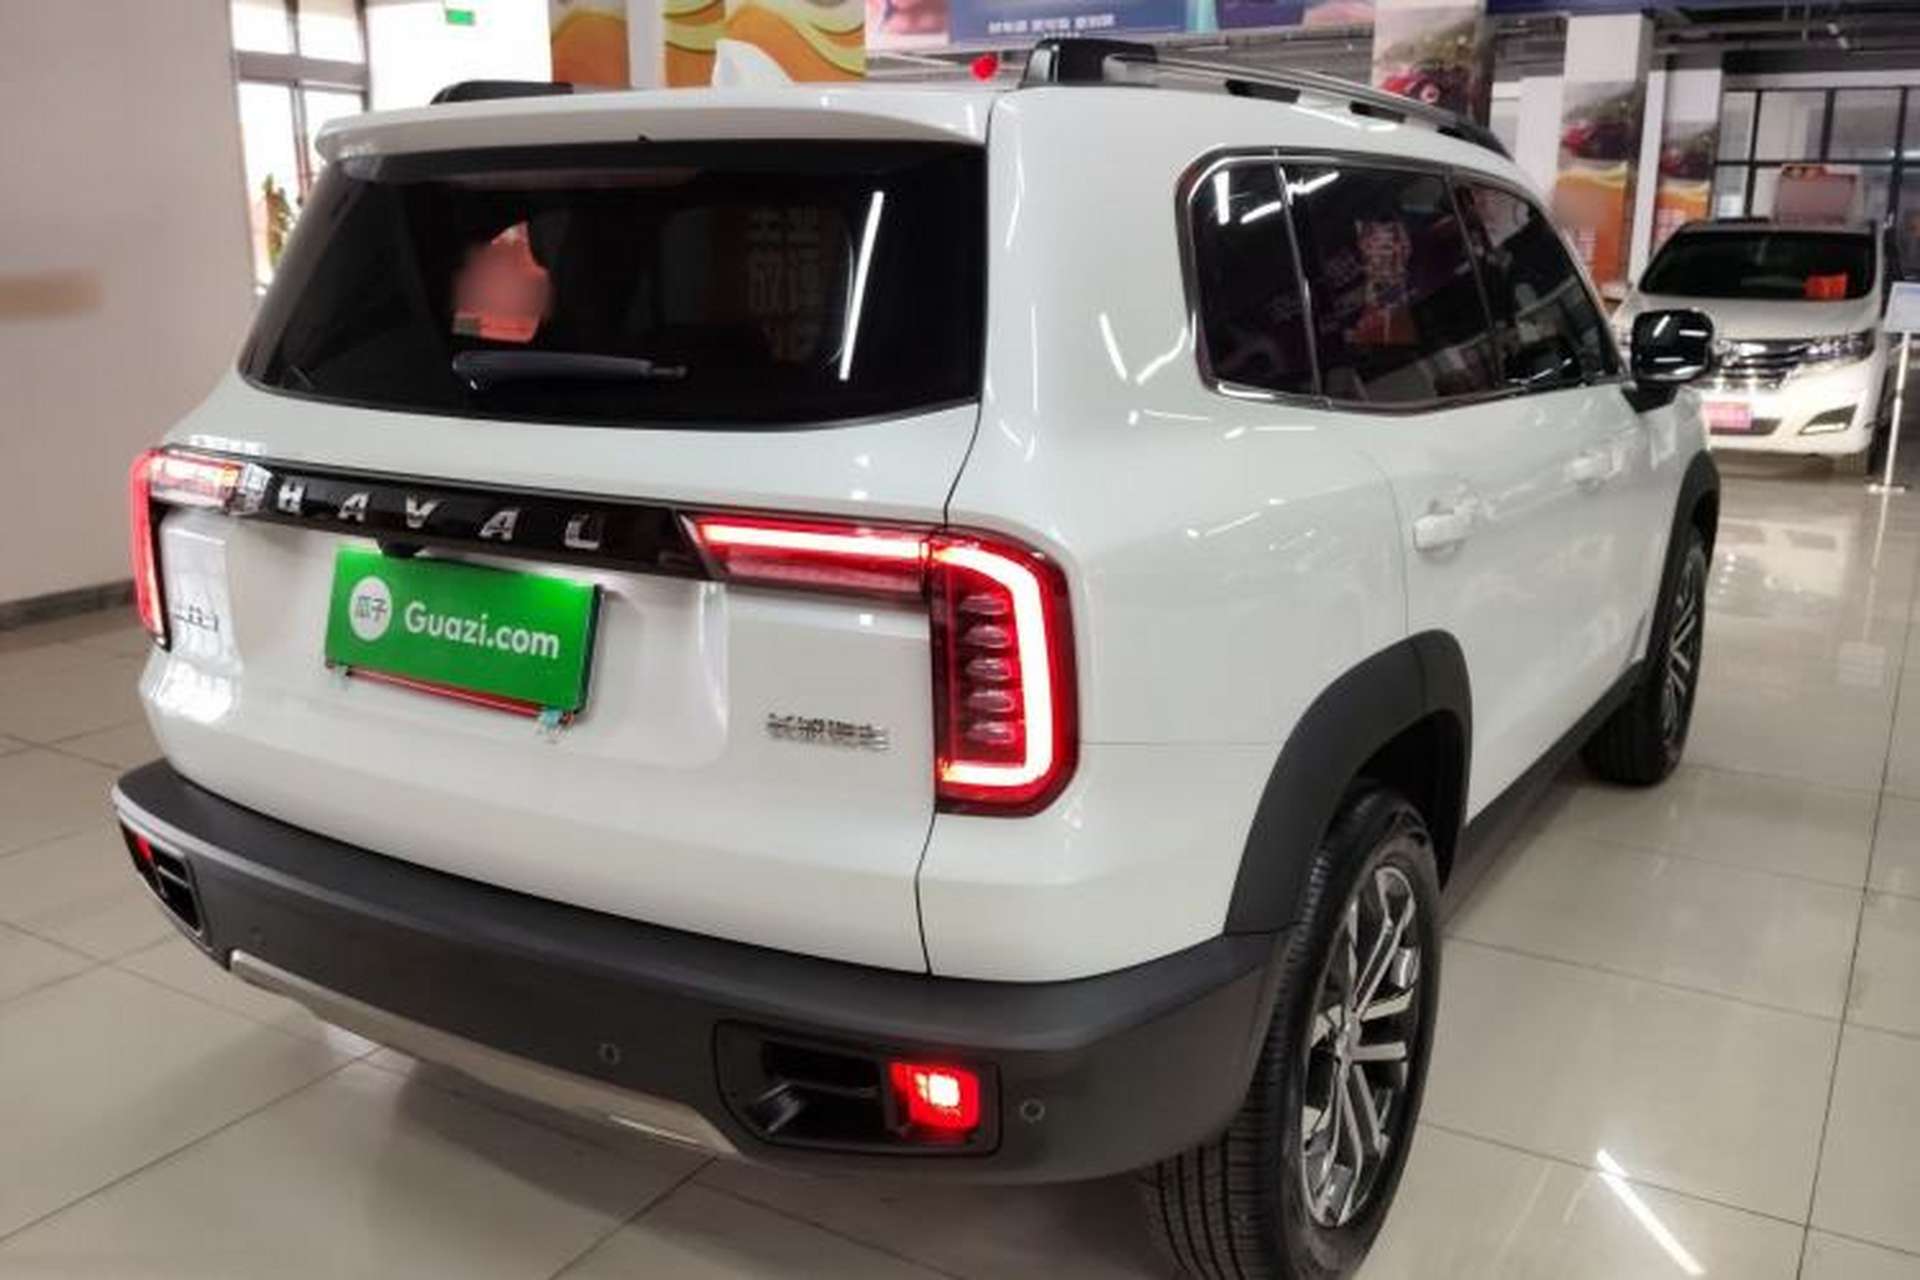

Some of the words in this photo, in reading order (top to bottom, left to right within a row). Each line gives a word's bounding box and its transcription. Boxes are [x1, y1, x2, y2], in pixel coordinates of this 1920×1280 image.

[278, 483, 600, 550] HAVAL
[354, 596, 388, 623] 瓜子
[404, 602, 560, 659] Guazi.com
